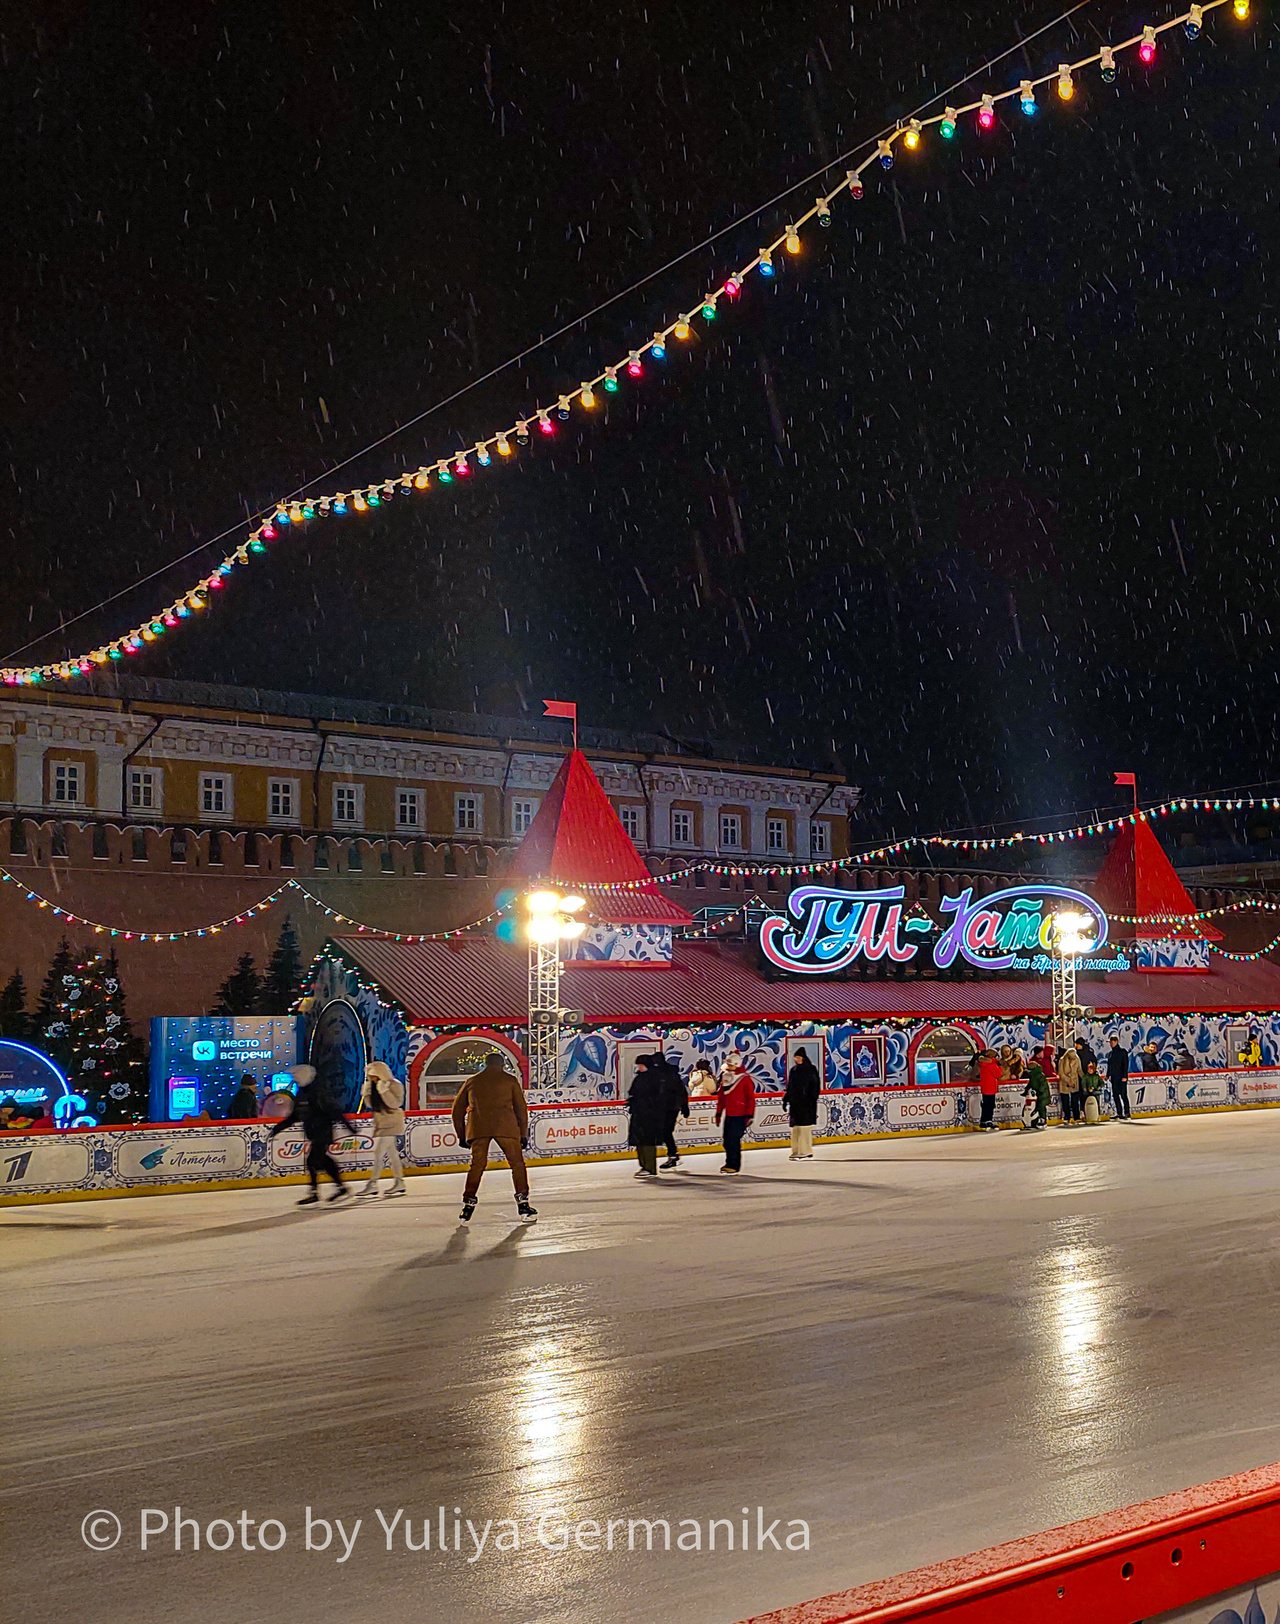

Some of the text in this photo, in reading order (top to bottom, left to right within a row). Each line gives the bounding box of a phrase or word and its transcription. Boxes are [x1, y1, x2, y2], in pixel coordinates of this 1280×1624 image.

[1013, 957, 1030, 970] на
[1083, 953, 1130, 973] площади
[220, 1039, 260, 1048] место
[220, 1050, 272, 1061] встречи
[1243, 1081, 1278, 1092] Альфа Банк
[900, 1102, 942, 1117] BOSCO
[995, 1102, 1022, 1110] ОВОСТИ
[546, 1122, 618, 1140] Альфа Банк
[170, 1151, 226, 1168] Лотерея
